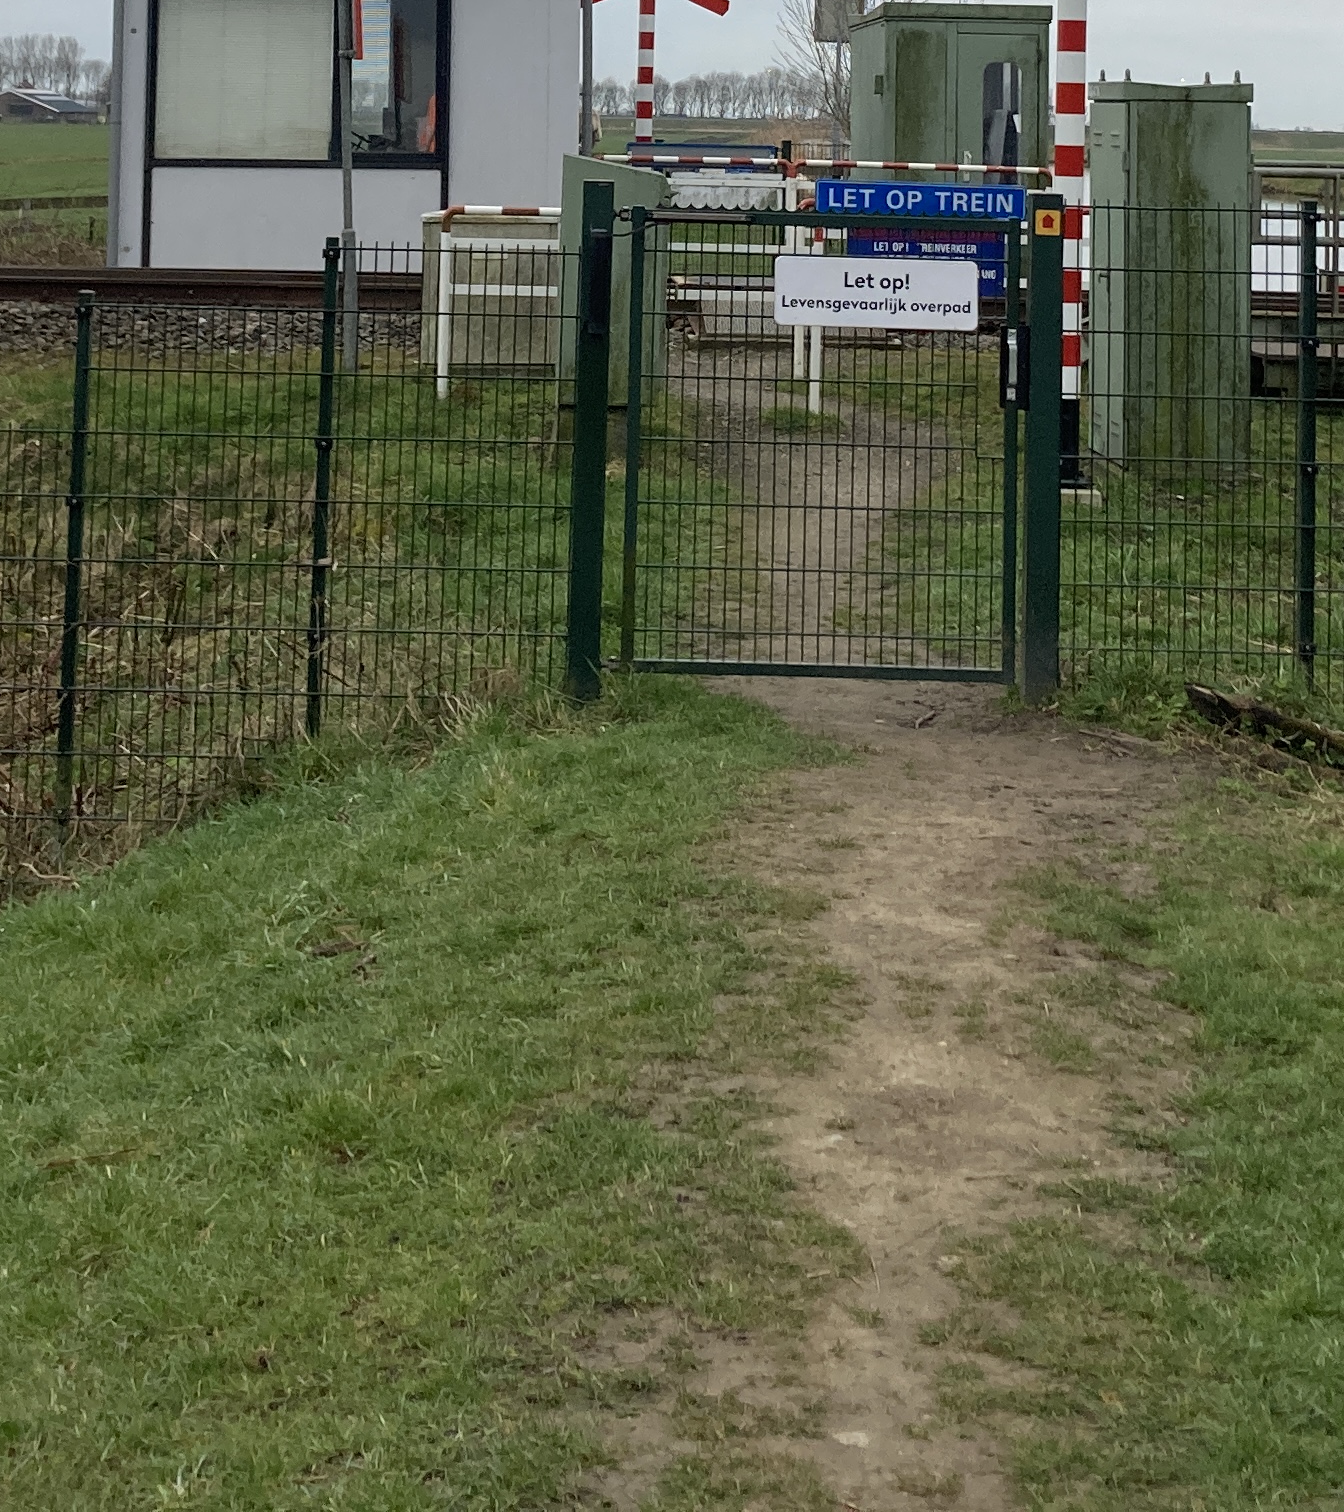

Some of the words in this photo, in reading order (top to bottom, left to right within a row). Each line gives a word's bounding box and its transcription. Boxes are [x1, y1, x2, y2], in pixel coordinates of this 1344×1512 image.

[828, 187, 876, 209] LET
[886, 189, 923, 210] OP
[934, 191, 1014, 214] TREIN
[843, 271, 875, 289] Let
[879, 273, 910, 295] op!
[781, 294, 907, 315] Levensgevaarlijk
[910, 300, 972, 316] overpad
